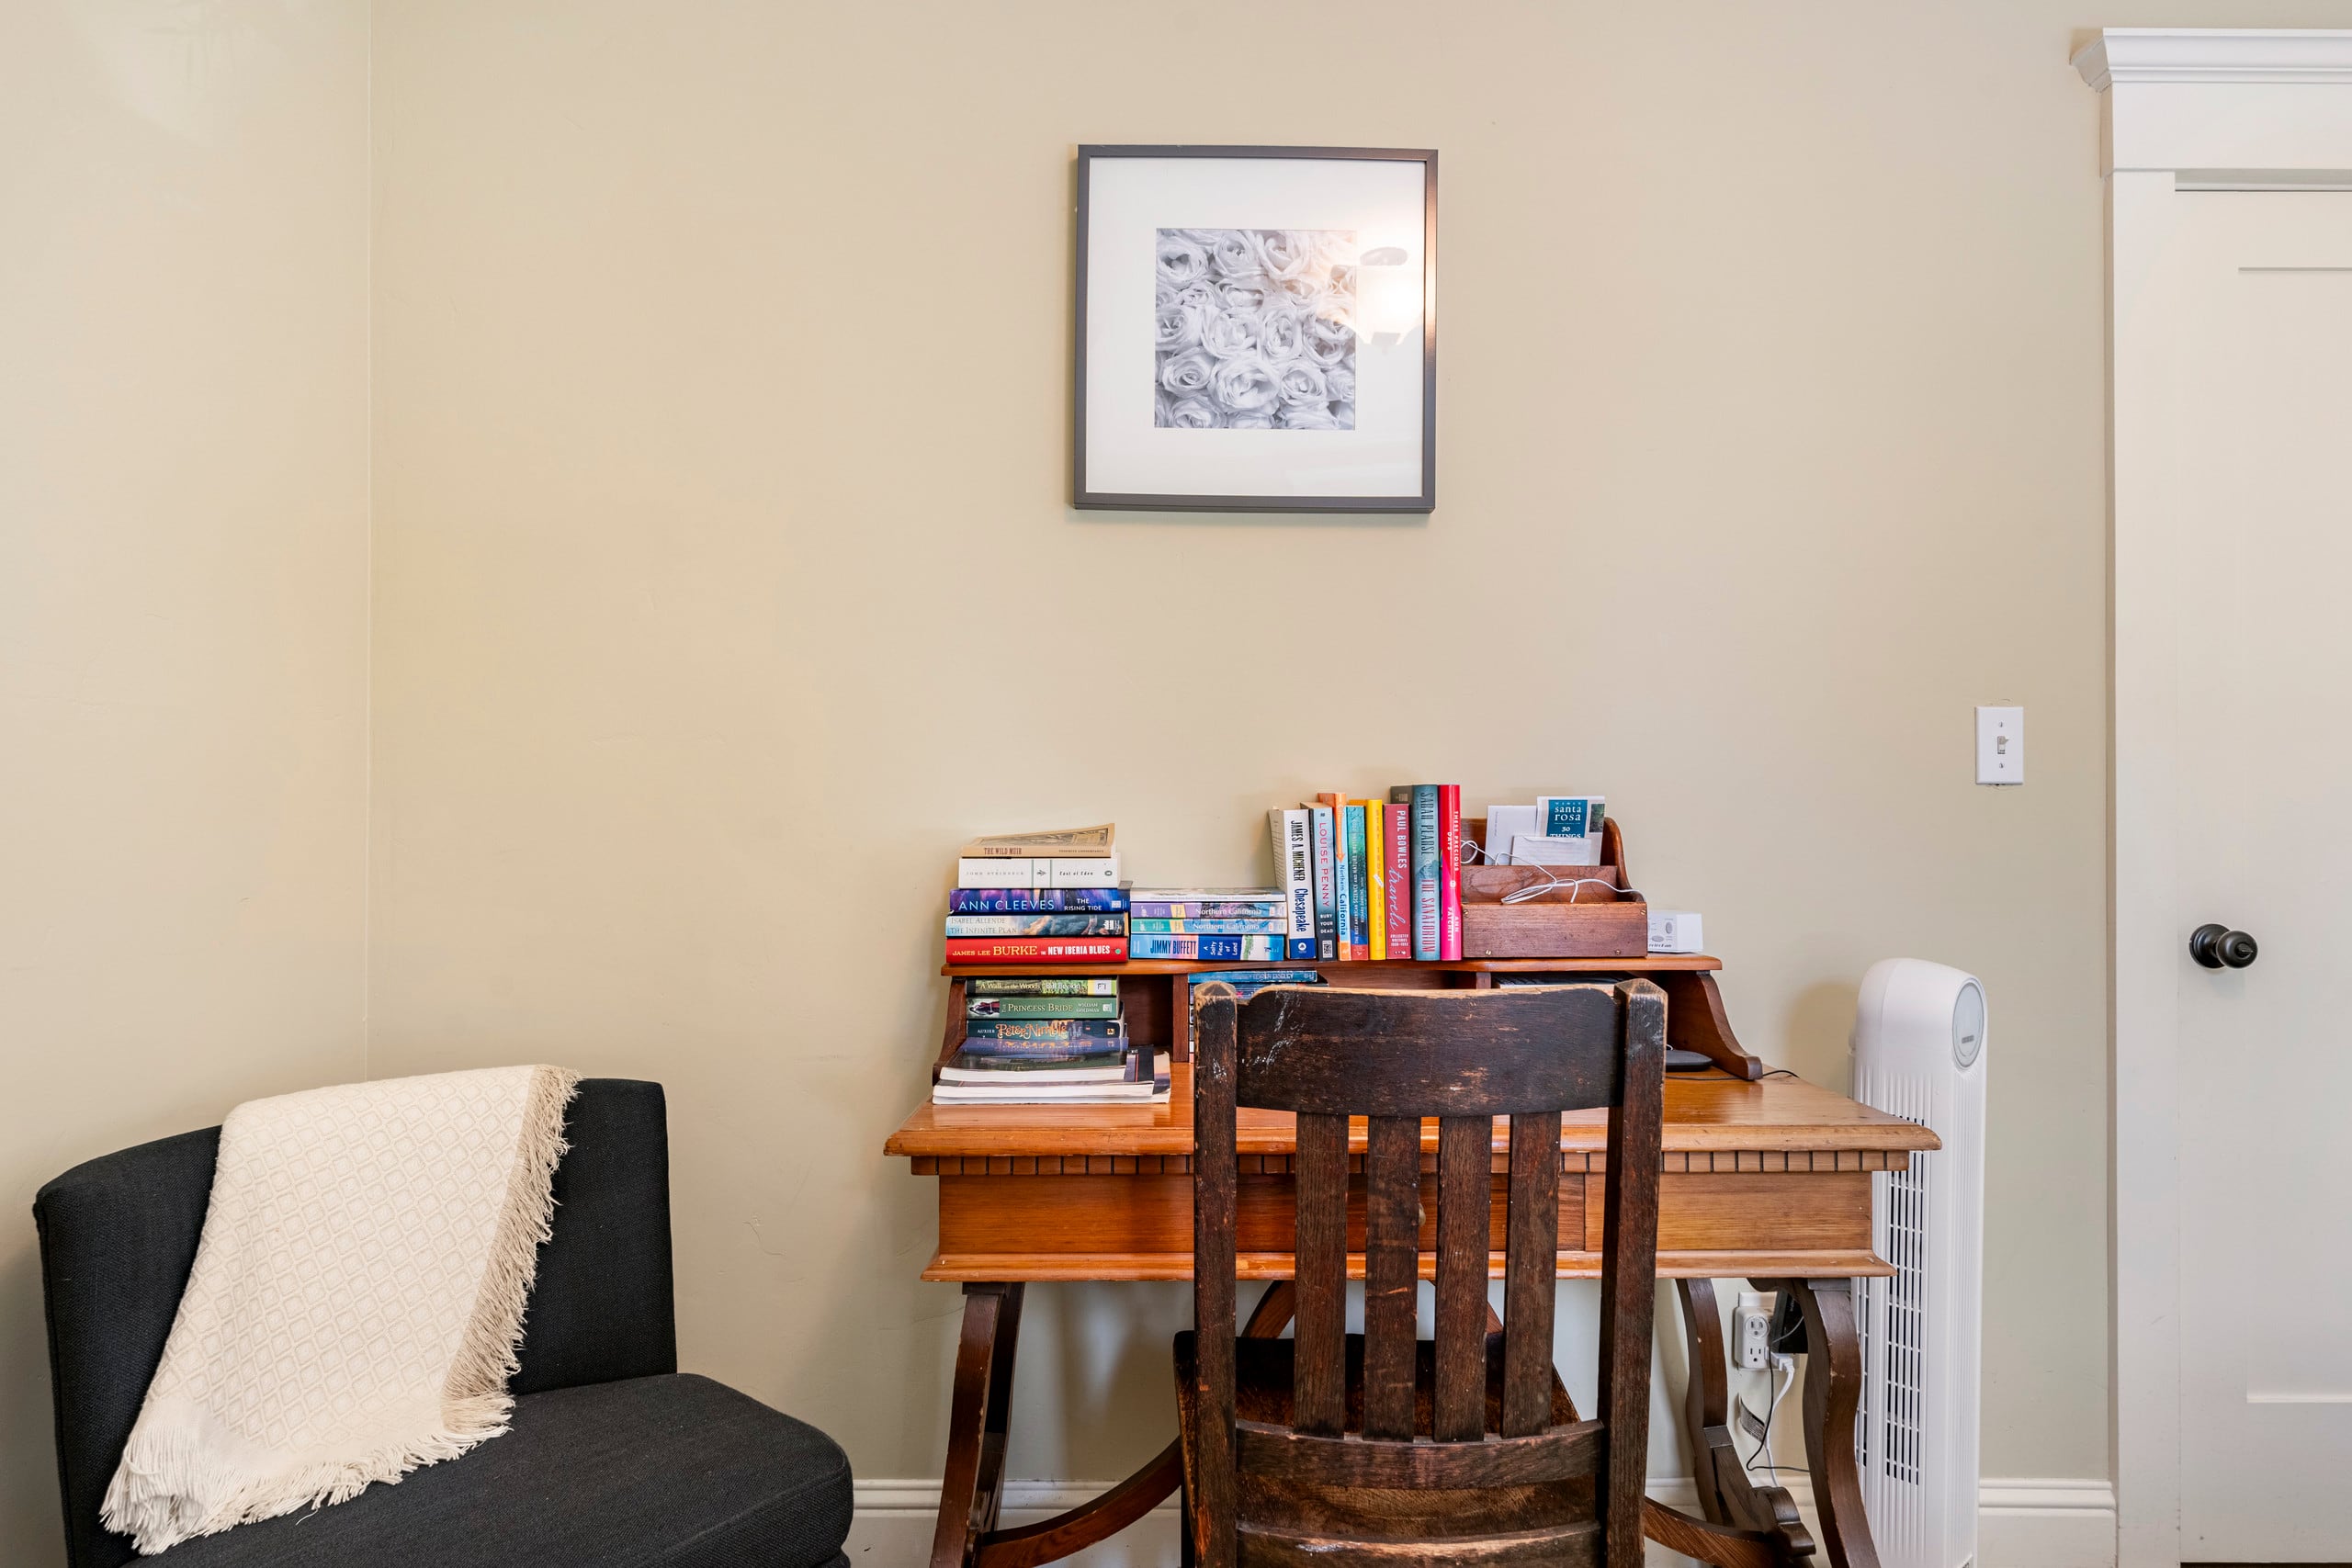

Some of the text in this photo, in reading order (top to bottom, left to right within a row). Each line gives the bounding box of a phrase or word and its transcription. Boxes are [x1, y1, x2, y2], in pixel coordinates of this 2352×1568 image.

[1420, 792, 1434, 823] SARAH
[1291, 820, 1303, 841] JAMES
[1397, 810, 1406, 832] PAUL
[1397, 836, 1407, 869] BOWLES
[1421, 827, 1434, 855] PEARSE
[1292, 851, 1305, 882] MICHENER
[1319, 823, 1332, 907] LOUISE PENNY
[1421, 879, 1435, 893] THE
[959, 900, 1054, 911] ANN CLEEVES
[1294, 888, 1310, 932] Chesapeake
[1388, 867, 1406, 931] travels
[1422, 898, 1436, 953] SANATORIUM
[993, 946, 1037, 956] BURKE
[1048, 947, 1063, 955] NEW
[1065, 946, 1088, 955] IBERIA
[1089, 945, 1110, 954] BLUES
[1150, 940, 1170, 953] JIMMY
[1172, 940, 1197, 954] BUFFETT
[1046, 981, 1081, 990] Bill Bryson
[995, 1024, 1067, 1039] Peter Nimble
